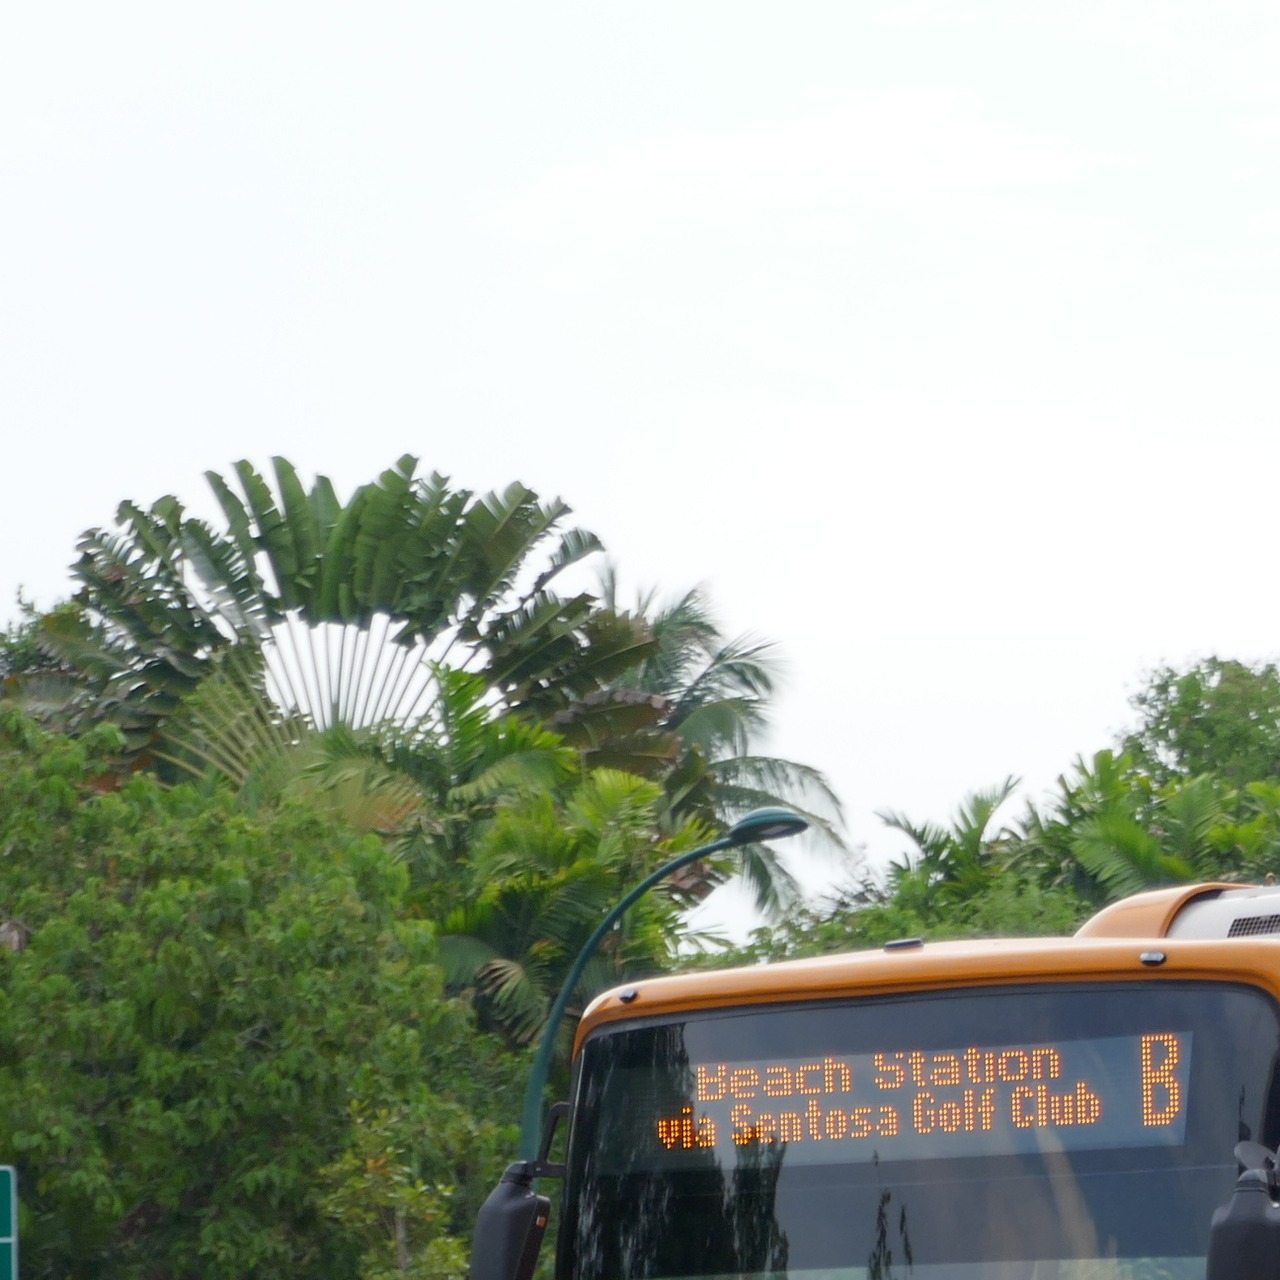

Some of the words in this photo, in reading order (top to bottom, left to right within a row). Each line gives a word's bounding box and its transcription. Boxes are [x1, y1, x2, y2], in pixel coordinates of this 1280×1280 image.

[696, 1056, 852, 1101] Beach
[873, 1046, 1061, 1090] Station
[1139, 1032, 1182, 1127] B
[656, 1107, 716, 1150] via
[730, 1103, 900, 1146] Sentosa
[912, 1087, 996, 1135] Golf
[1010, 1080, 1102, 1130] Club
